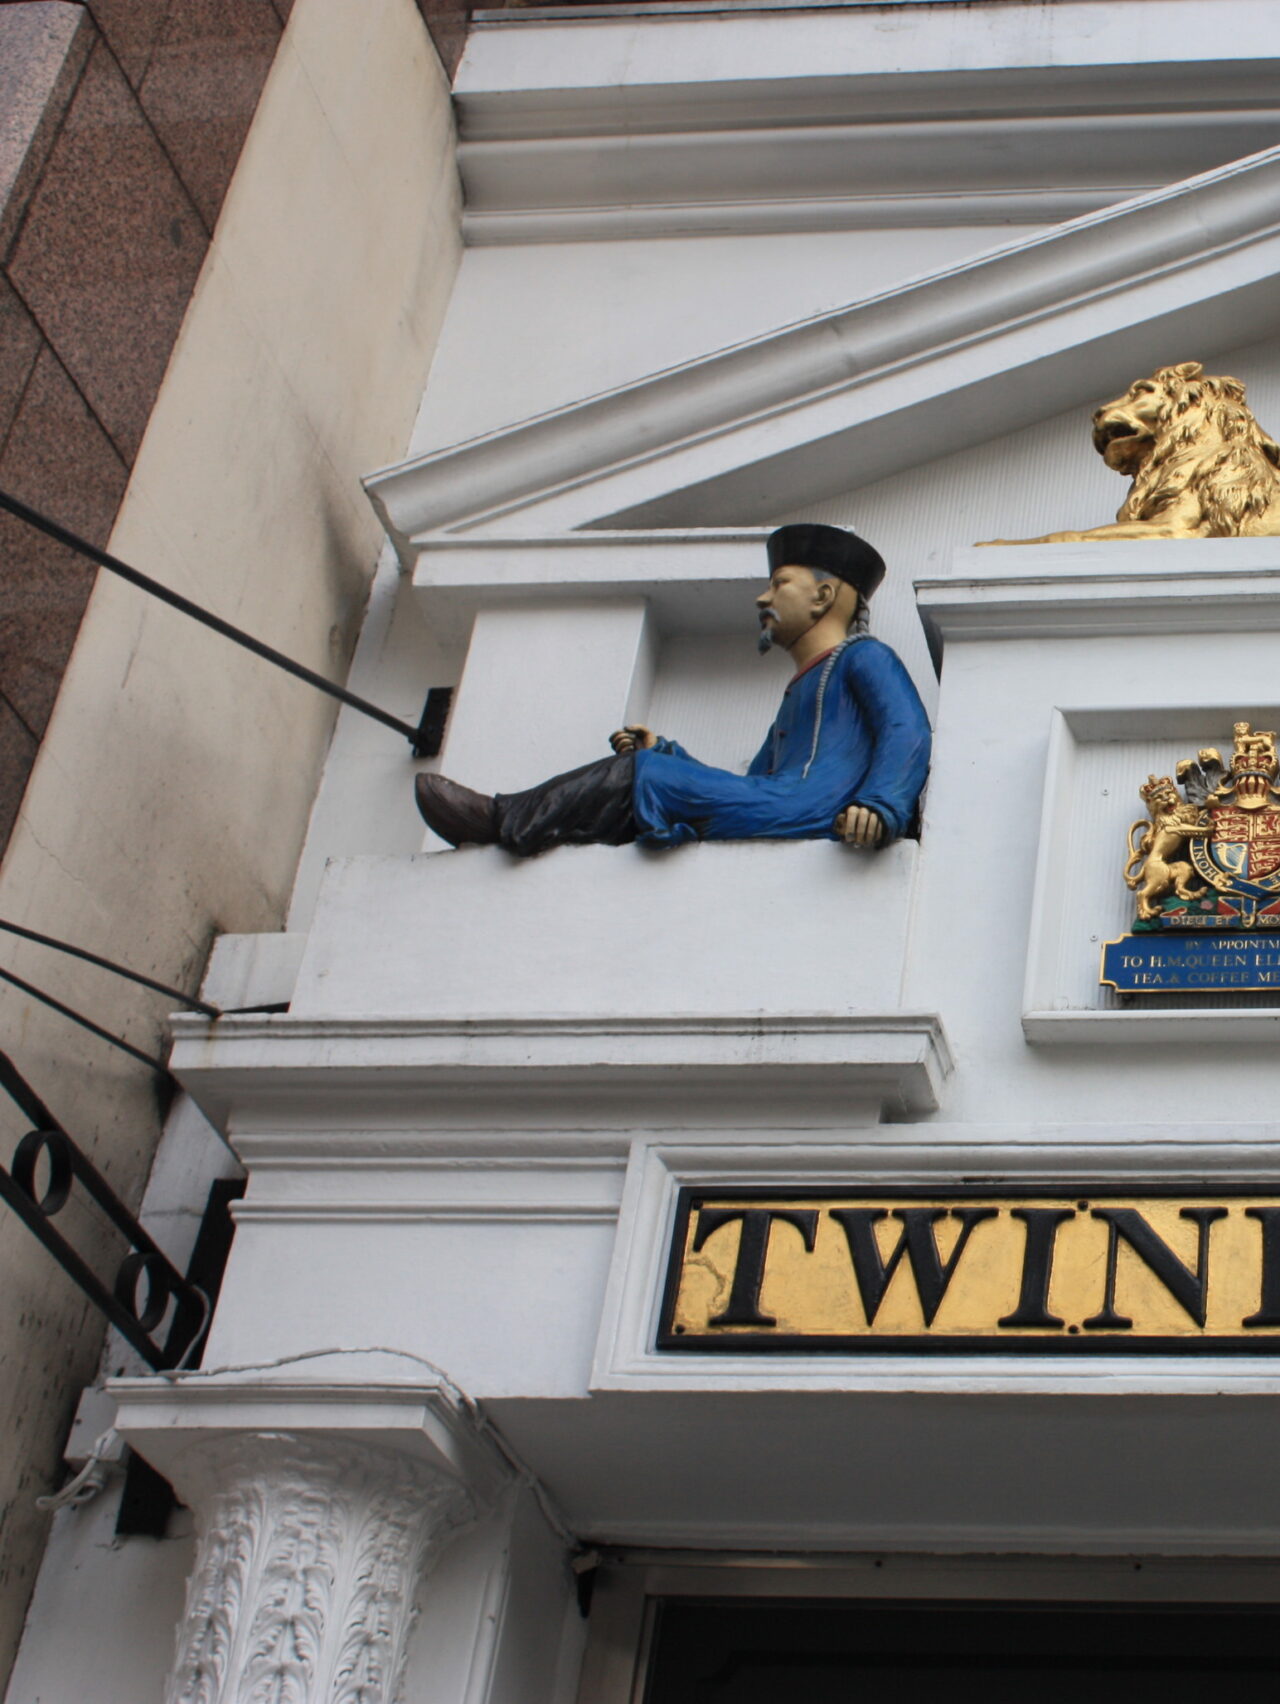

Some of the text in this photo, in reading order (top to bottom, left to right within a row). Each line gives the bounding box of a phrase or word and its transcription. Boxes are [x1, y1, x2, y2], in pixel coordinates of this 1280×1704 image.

[1121, 955, 1143, 968] TO
[1133, 973, 1162, 984] TEA
[1187, 972, 1249, 983] COFFEE
